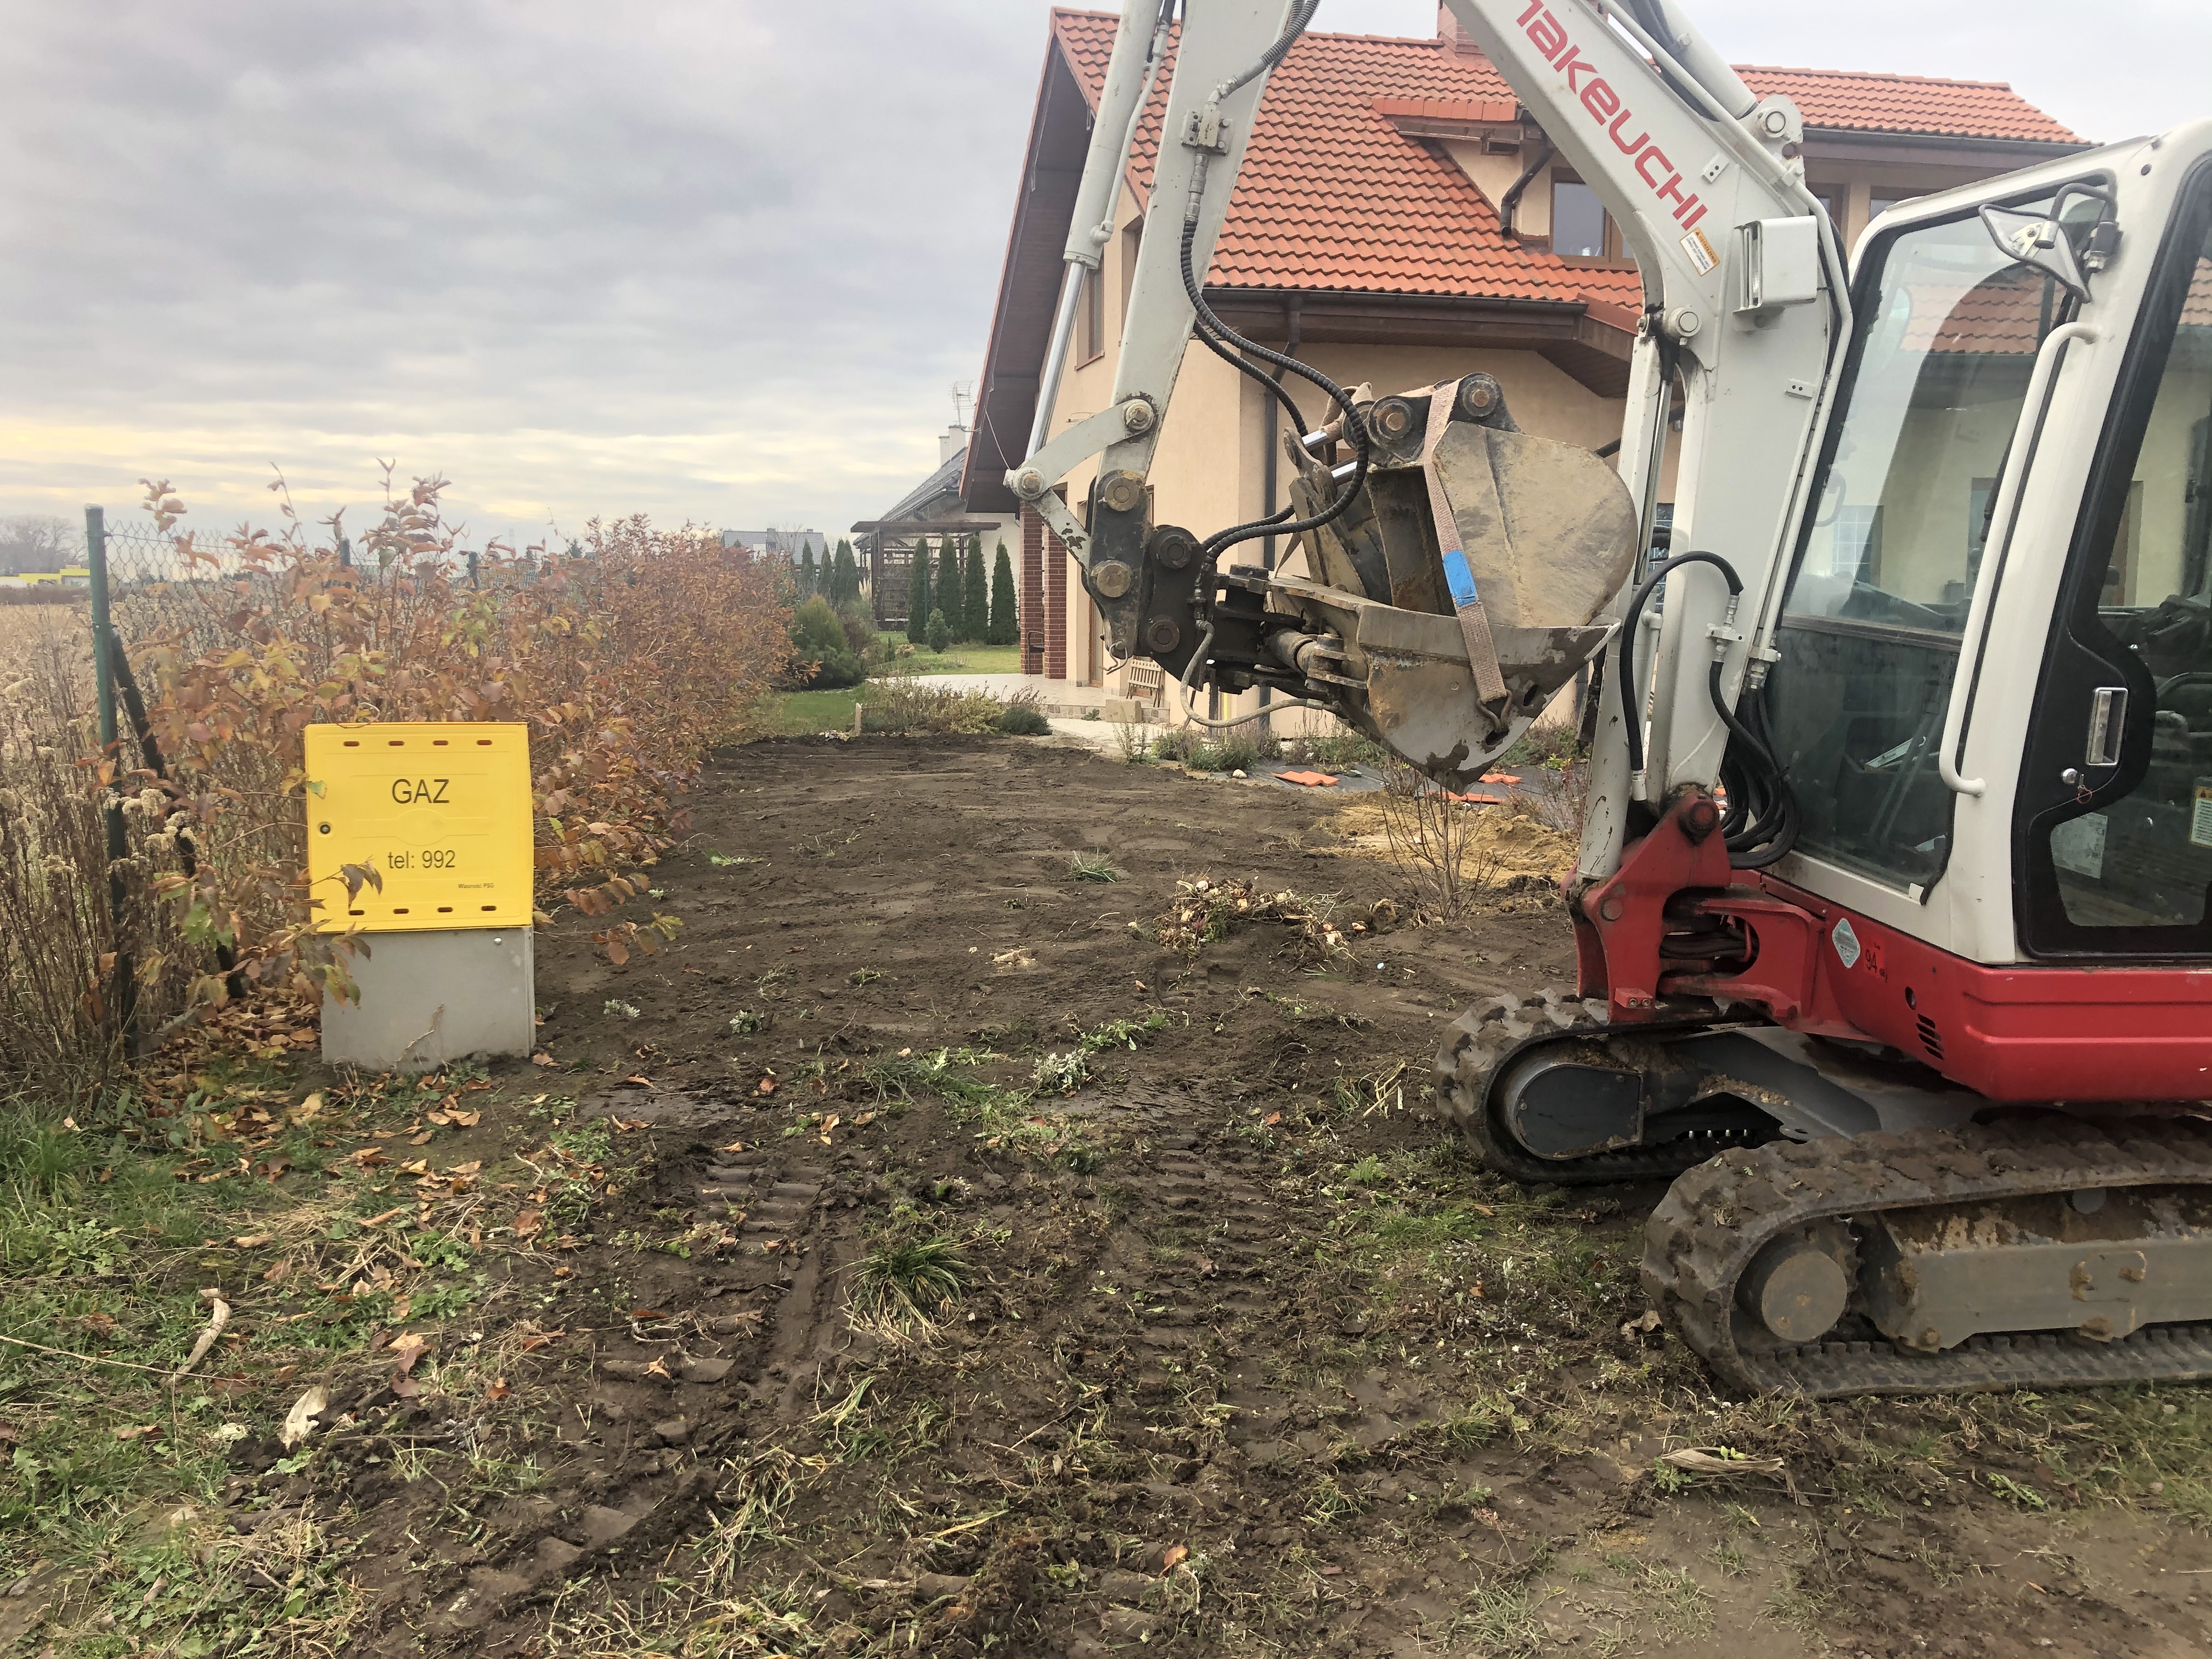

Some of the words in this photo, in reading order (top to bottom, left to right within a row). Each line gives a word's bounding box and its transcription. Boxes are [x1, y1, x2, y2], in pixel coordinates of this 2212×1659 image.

[392, 779, 449, 804] GAZ
[388, 851, 415, 869] tel:
[422, 850, 455, 868] 992
